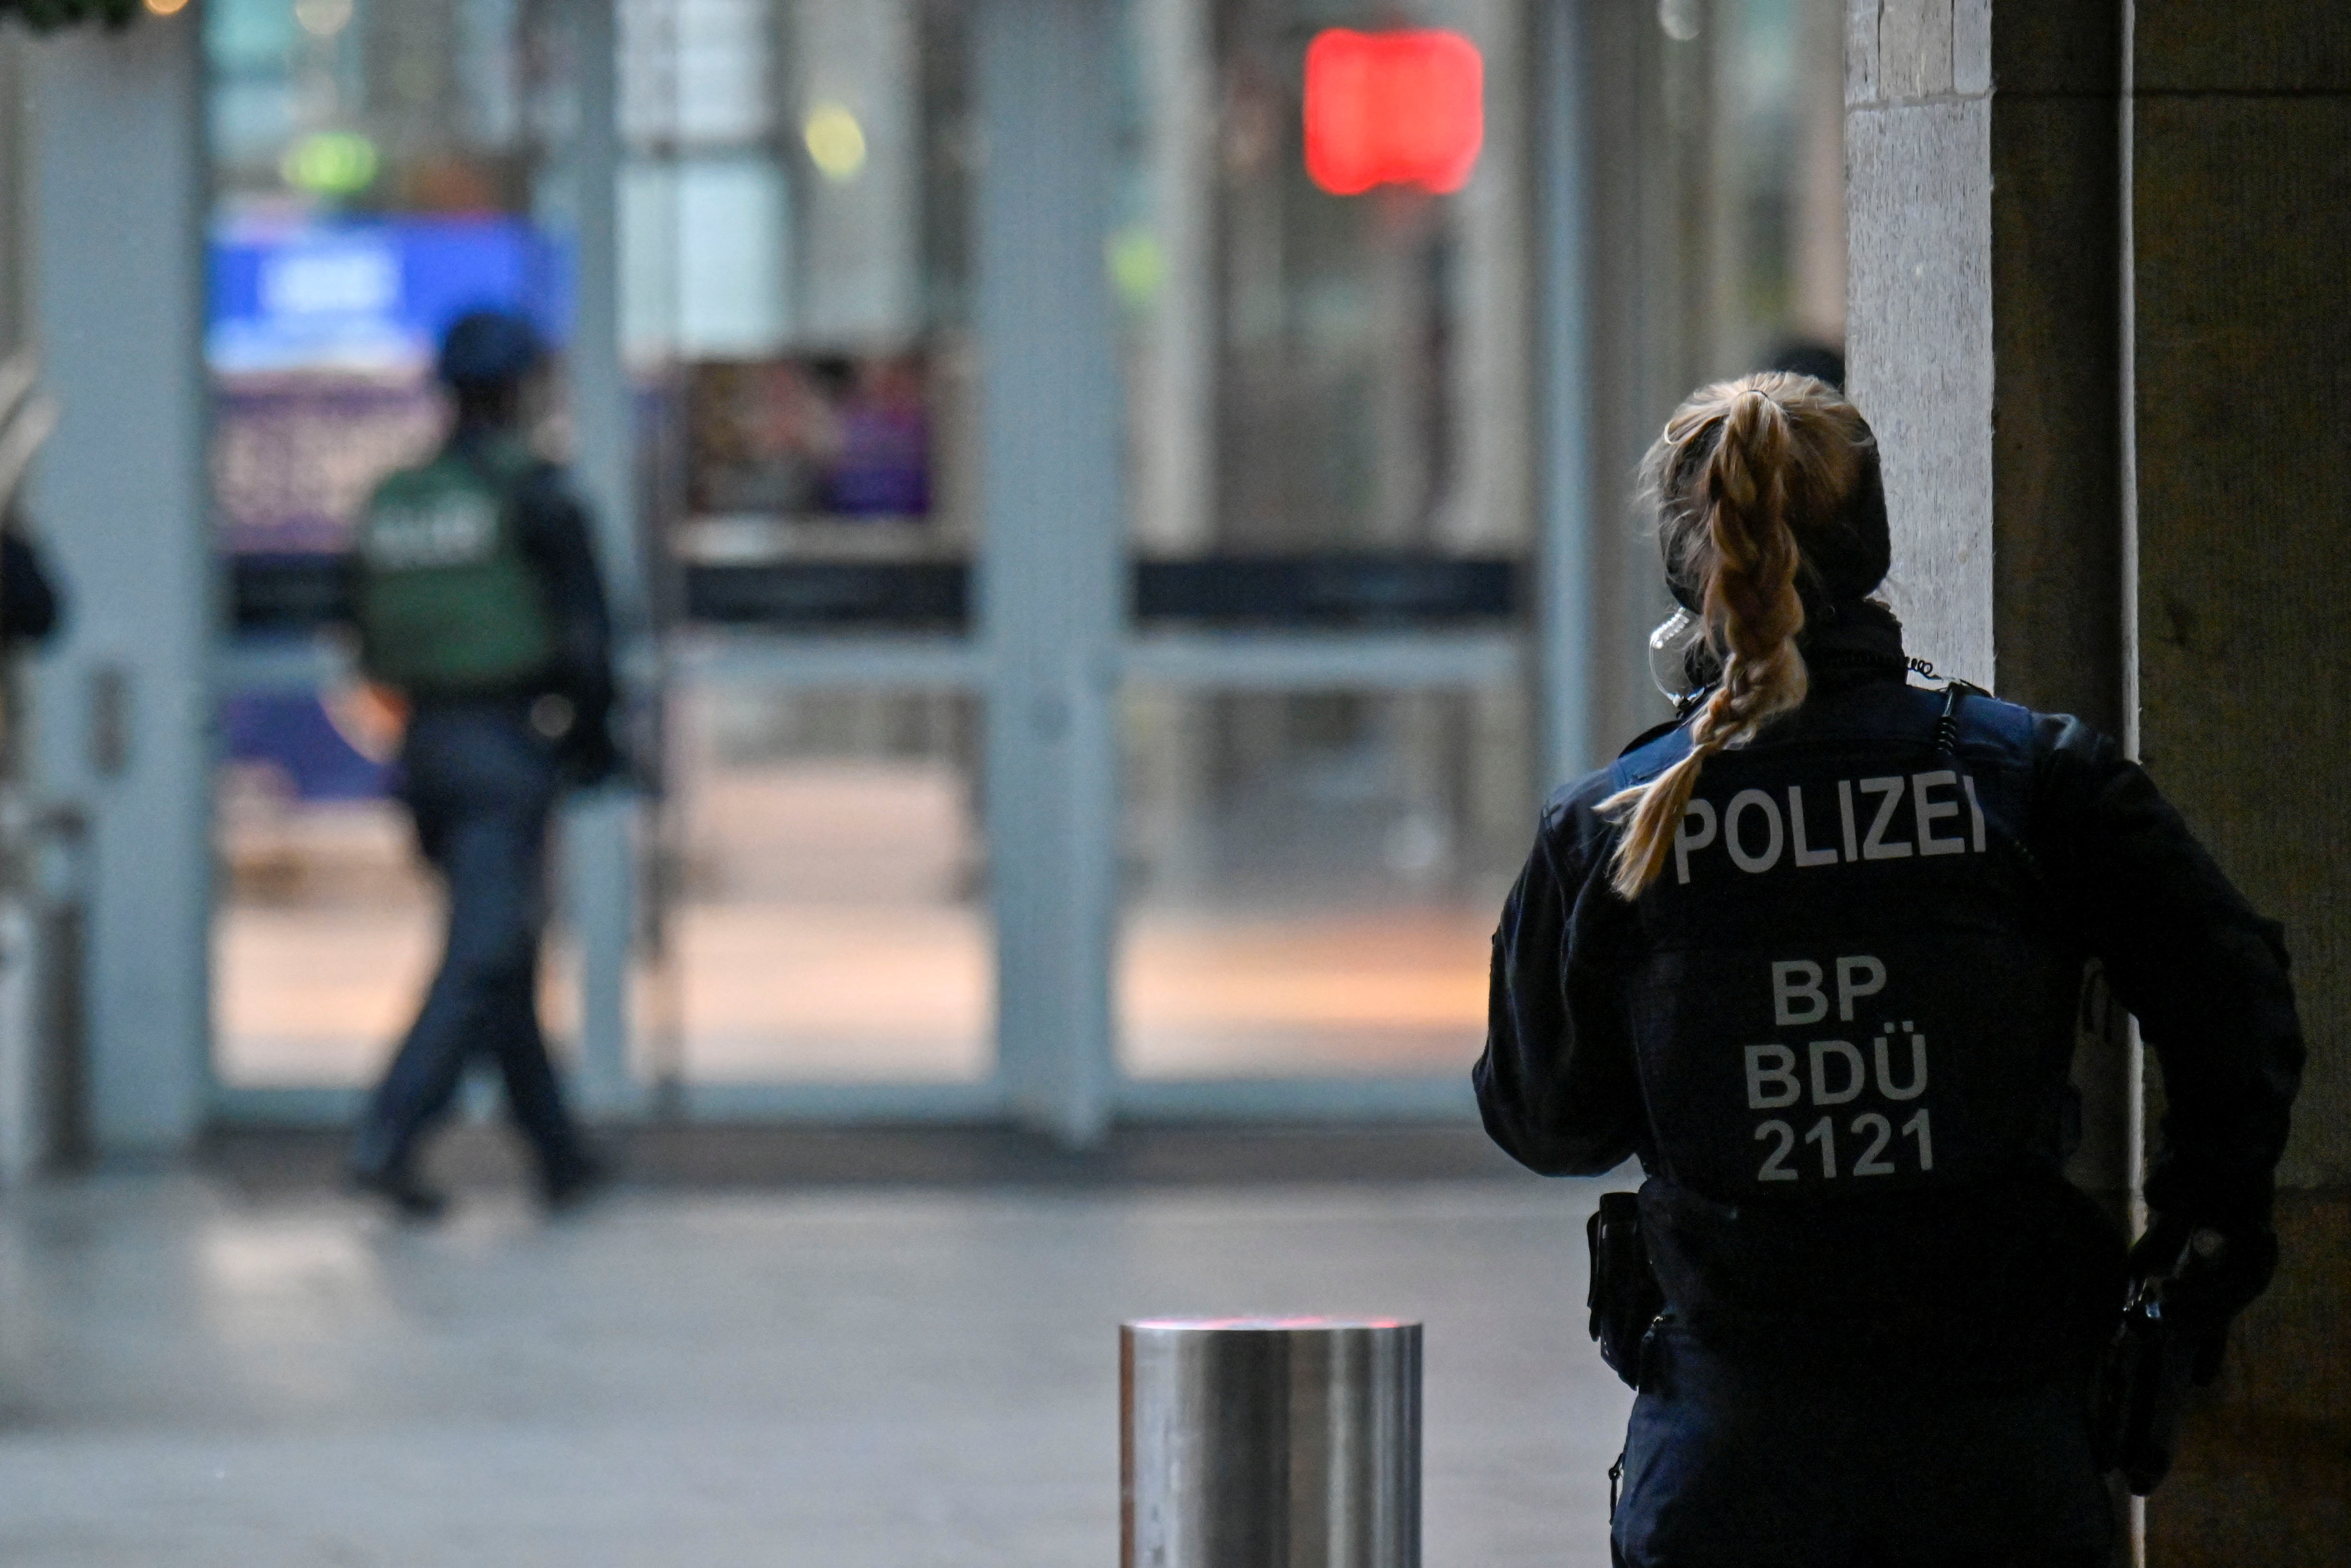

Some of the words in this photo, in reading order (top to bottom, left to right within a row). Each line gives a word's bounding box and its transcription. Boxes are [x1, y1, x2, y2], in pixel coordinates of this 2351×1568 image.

[1673, 770, 1987, 885] POLIZEI
[1771, 955, 1887, 1026] BP
[1743, 1020, 1928, 1109] BDÜ
[1754, 1107, 1934, 1182] 2121
